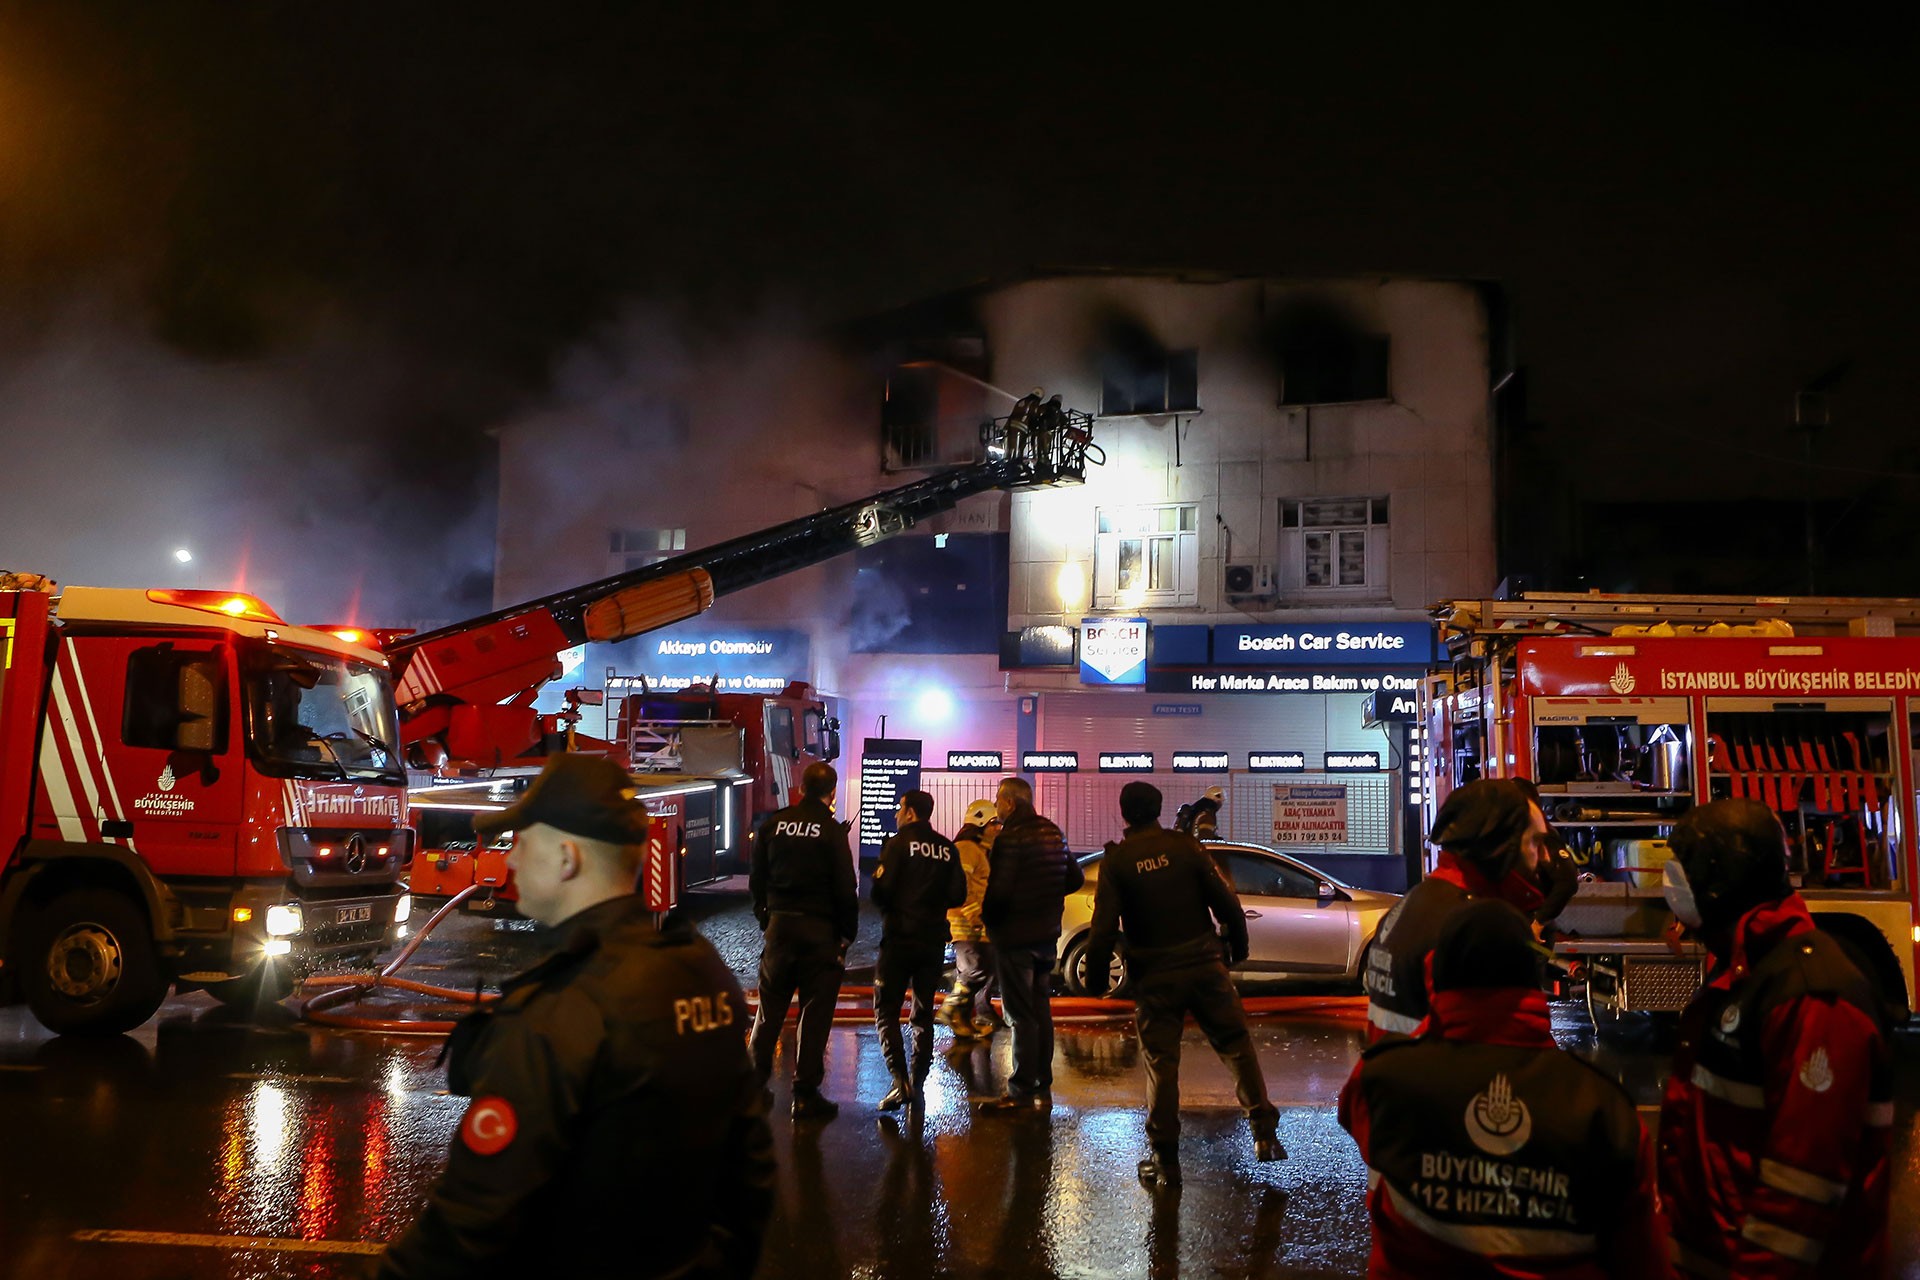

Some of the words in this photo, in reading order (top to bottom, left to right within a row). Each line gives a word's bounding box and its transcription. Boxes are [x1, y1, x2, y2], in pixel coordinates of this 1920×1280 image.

[658, 640, 706, 657] Akkaya
[709, 639, 773, 656] Otomotiv
[1238, 633, 1295, 651] Bosch
[1299, 633, 1333, 650] Car
[1336, 632, 1405, 650] Service
[728, 678, 742, 688] ve
[1191, 675, 1217, 690] Her
[1219, 675, 1265, 690] Marka
[1266, 675, 1310, 690] Araca
[1312, 675, 1359, 690] Bakım
[1360, 678, 1380, 690] ve
[1661, 668, 1740, 690] İSTANBUL
[1745, 668, 1850, 694] BÜYÜKŞEHİR
[1855, 667, 1920, 690] BELEDİY
[949, 755, 1001, 768] KAPORTA
[134, 799, 195, 811] BÜYÜKŞEHİR
[775, 820, 822, 838] POLİS
[1277, 832, 1297, 841] 0531
[1300, 832, 1317, 841] 792
[1331, 832, 1342, 841] 24
[909, 840, 951, 862] POLİS
[1421, 1151, 1571, 1198] BÜYÜKŞEHİR
[1410, 1181, 1450, 1211] 112
